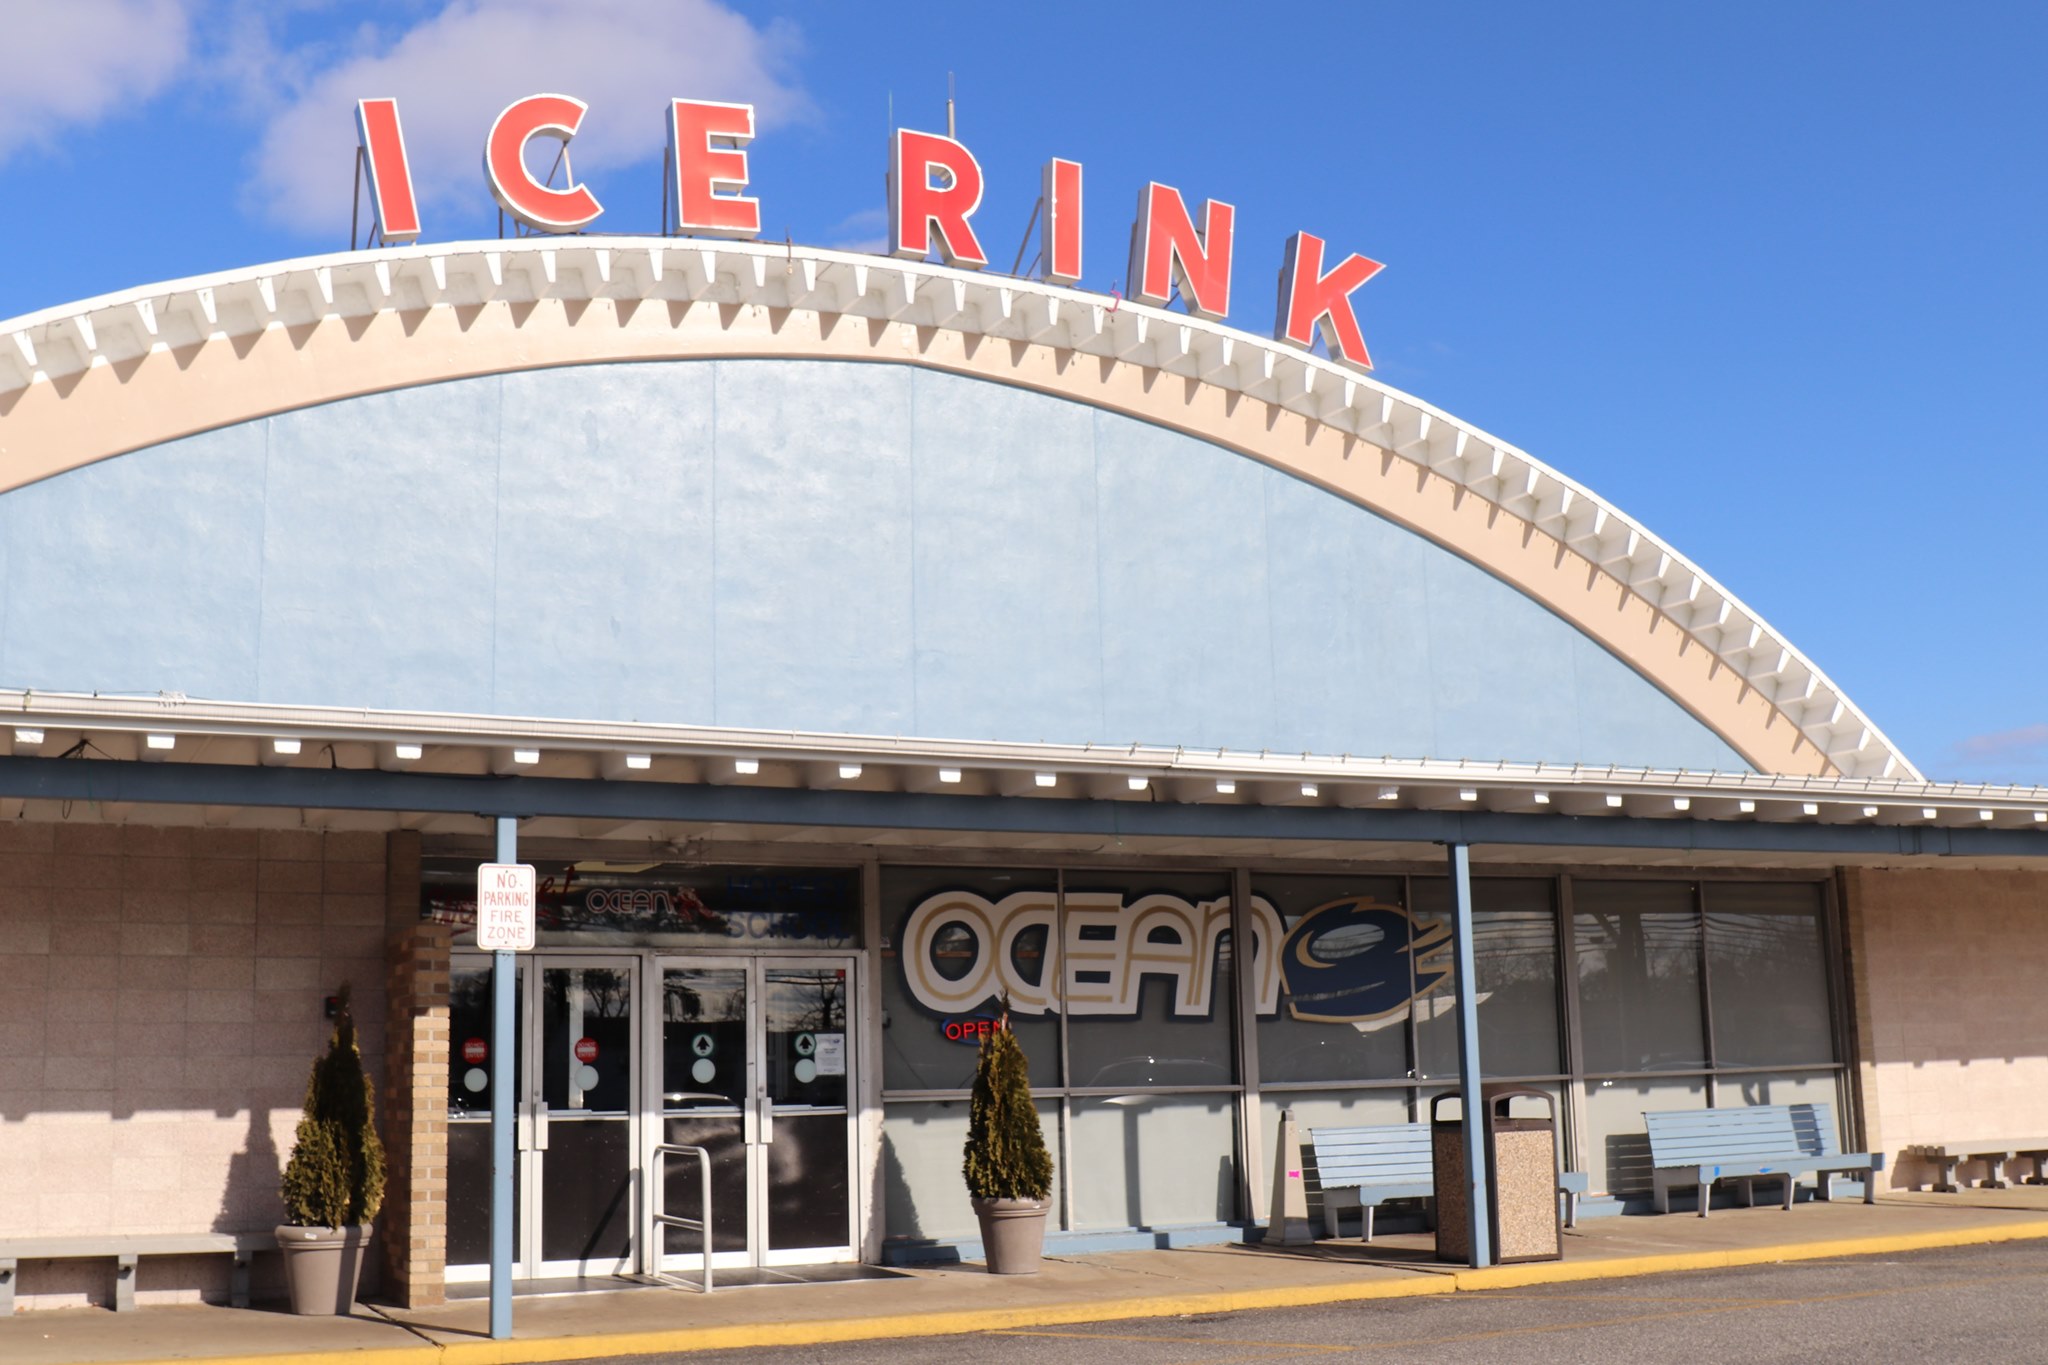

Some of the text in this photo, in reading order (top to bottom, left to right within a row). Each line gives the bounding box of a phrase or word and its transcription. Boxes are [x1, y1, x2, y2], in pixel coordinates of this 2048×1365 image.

[356, 93, 1388, 371] ICE RINK
[497, 874, 517, 888] NO
[484, 891, 529, 907] PARKING
[586, 889, 677, 914] OCEAN
[490, 909, 523, 923] FIRE
[487, 926, 526, 939] ZONE
[901, 890, 1282, 1017] OCEAN
